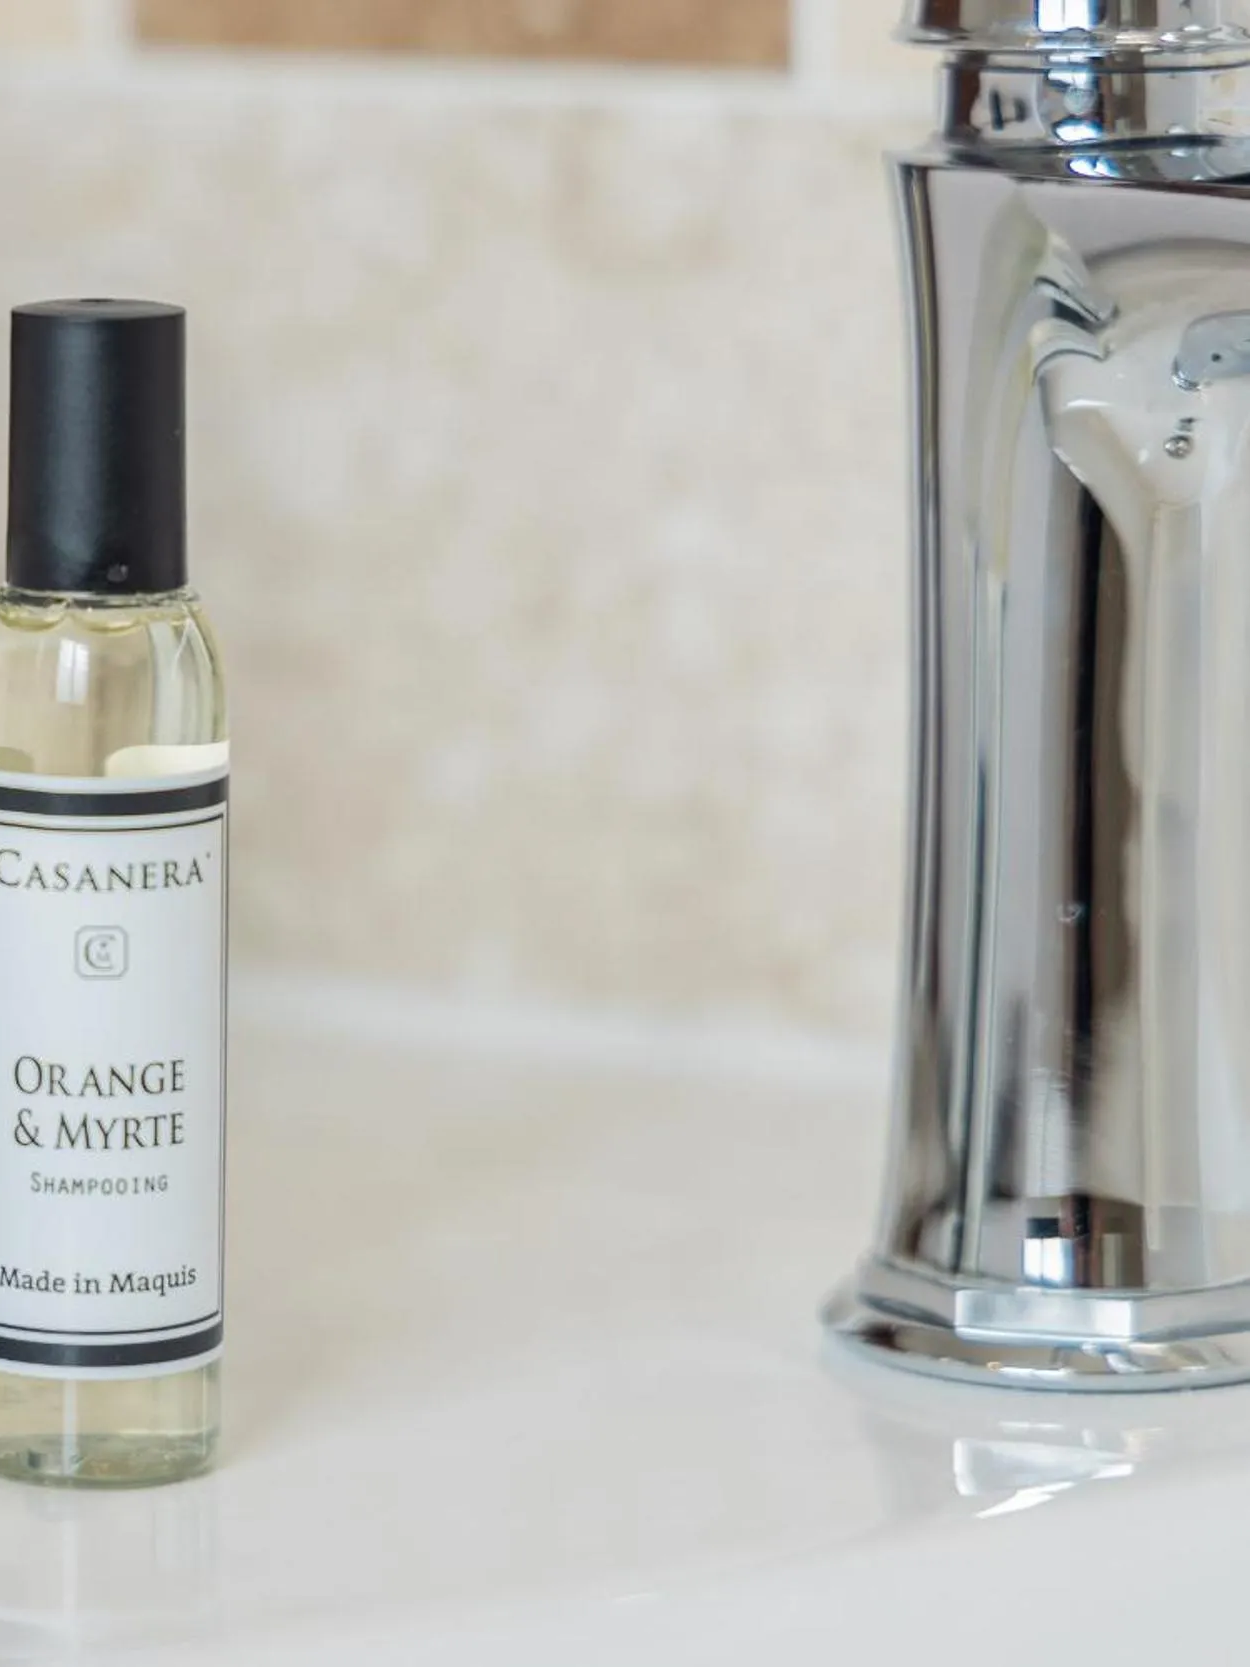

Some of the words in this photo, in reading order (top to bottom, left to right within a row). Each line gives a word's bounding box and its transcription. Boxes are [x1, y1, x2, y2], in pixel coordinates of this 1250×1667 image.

[13, 1055, 185, 1098] ORANGE
[13, 1108, 44, 1148] &
[54, 1112, 185, 1150] MYRTE
[30, 1171, 169, 1195] SHAMPOOING
[73, 1272, 101, 1295] in
[109, 1265, 198, 1297] Maquis
